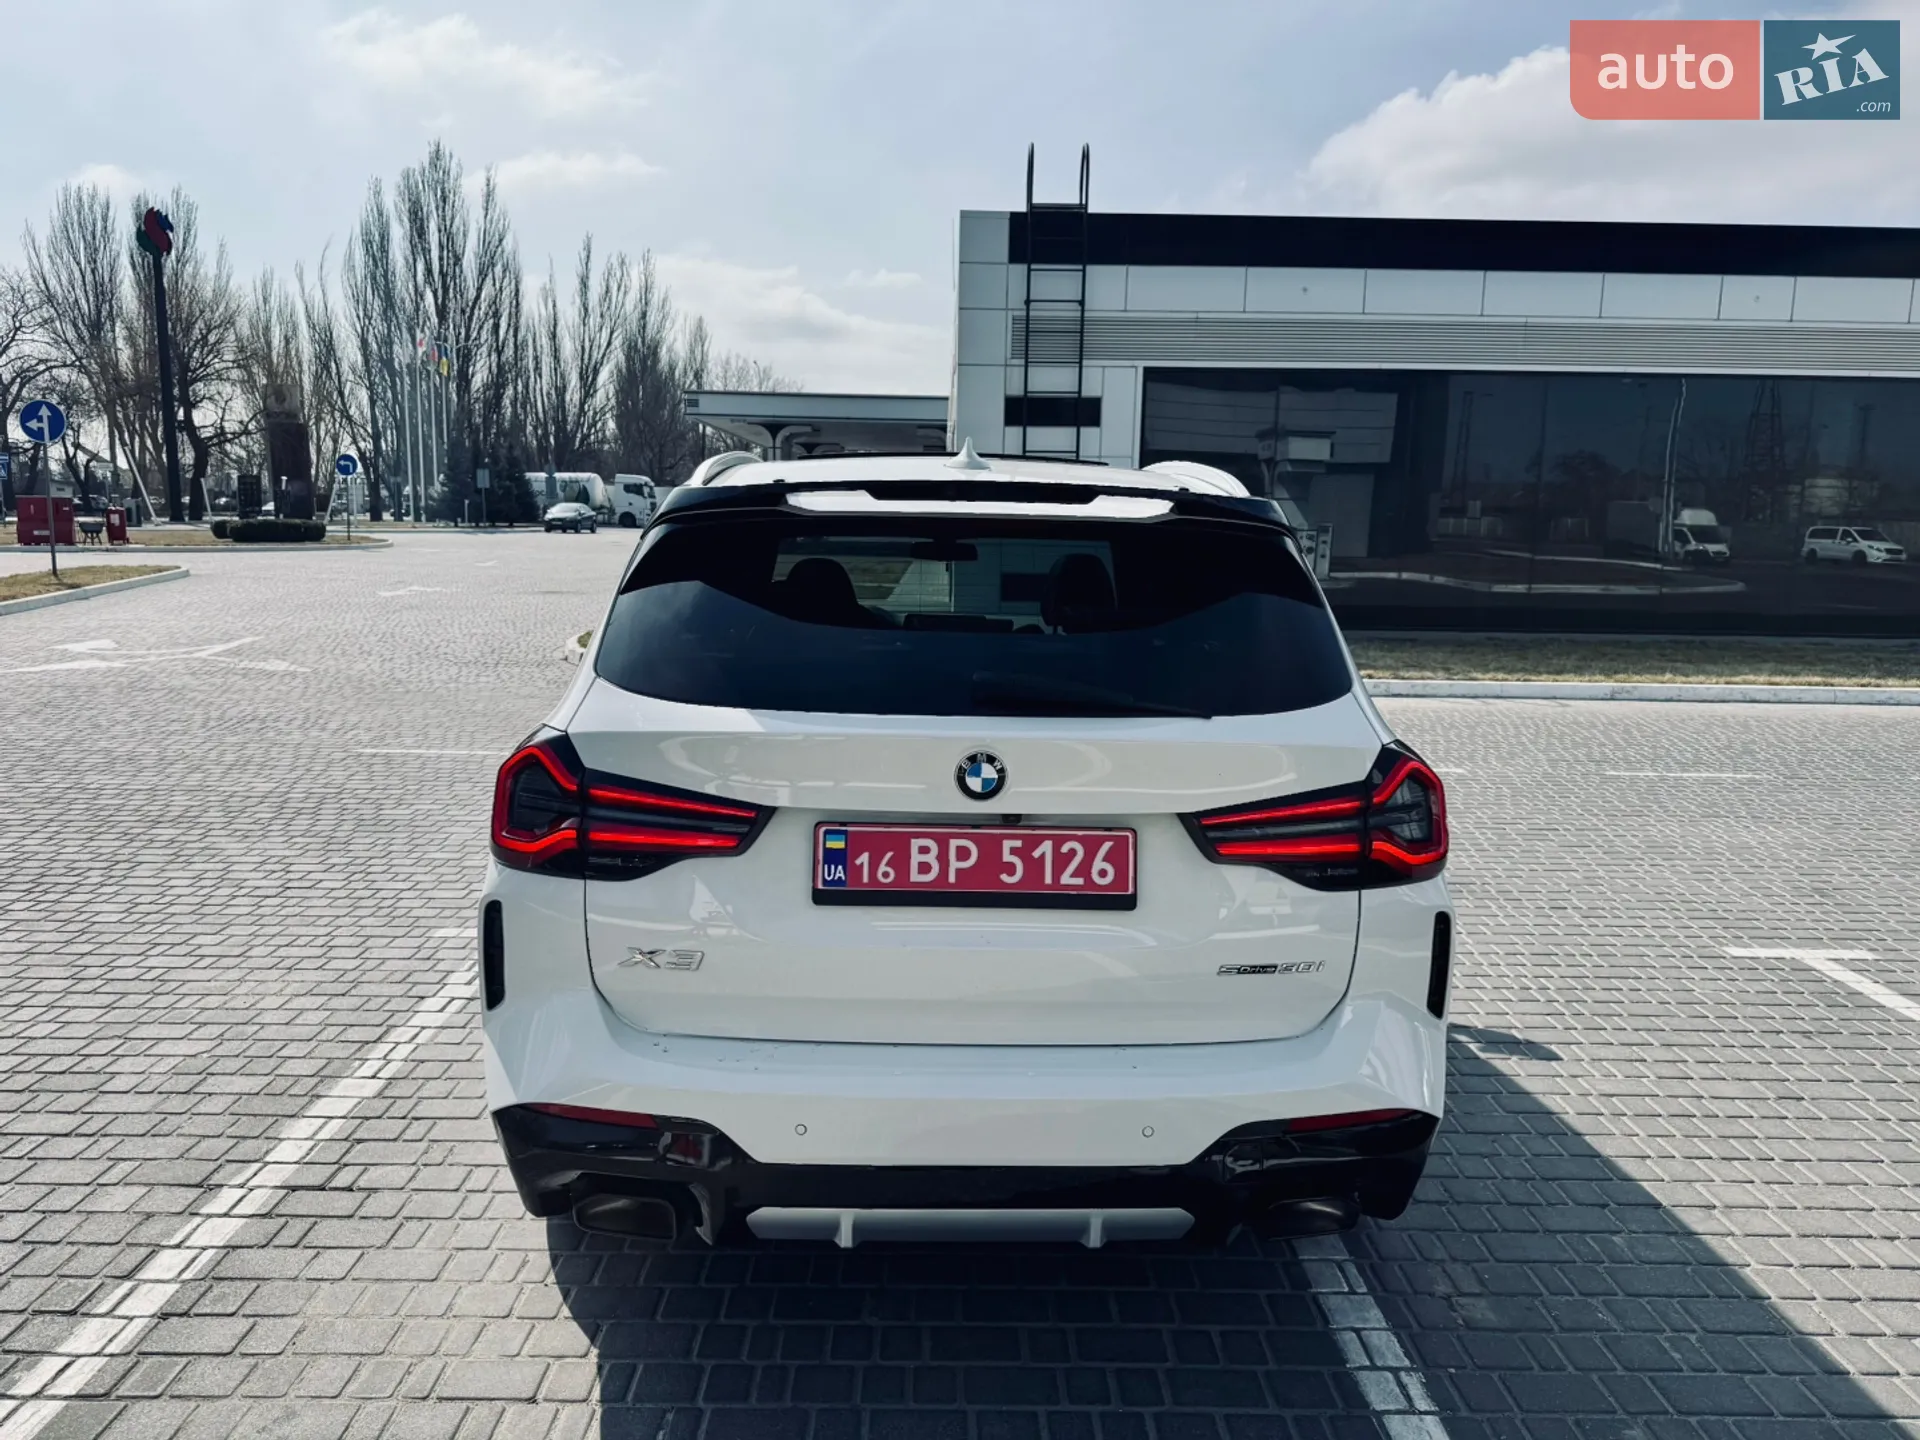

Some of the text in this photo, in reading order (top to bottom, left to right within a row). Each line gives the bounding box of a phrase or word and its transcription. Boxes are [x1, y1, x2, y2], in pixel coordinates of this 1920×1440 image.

[961, 753, 1003, 770] BMW
[823, 864, 846, 881] UA
[854, 838, 1115, 886] 16 BP 5126
[617, 946, 705, 971] X3
